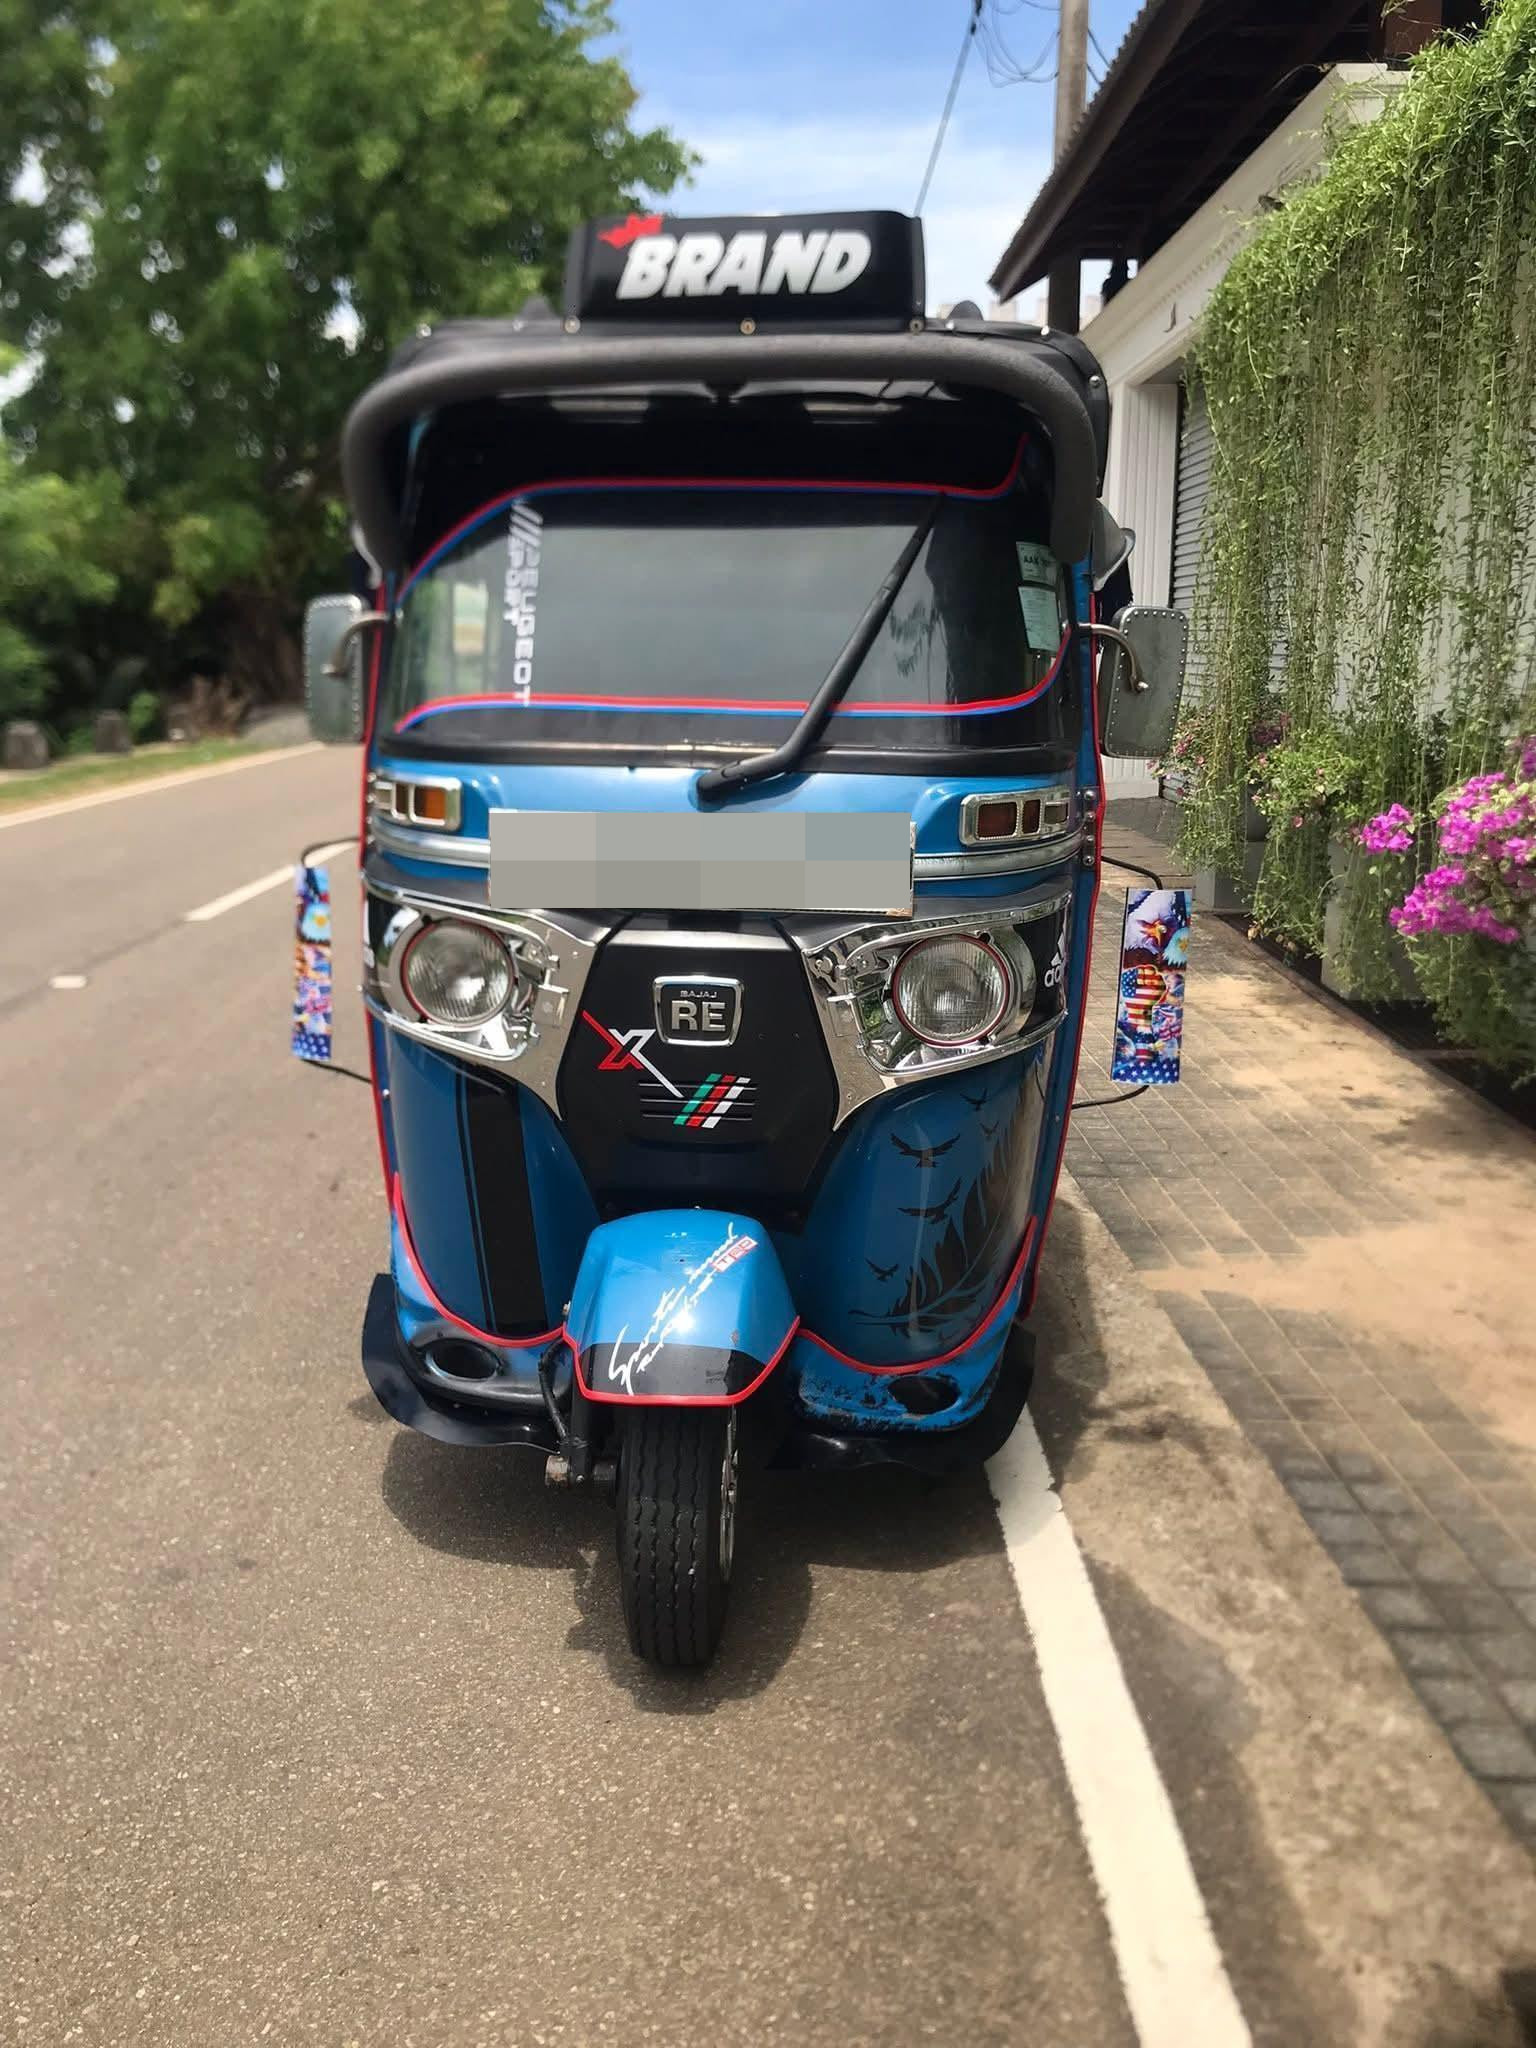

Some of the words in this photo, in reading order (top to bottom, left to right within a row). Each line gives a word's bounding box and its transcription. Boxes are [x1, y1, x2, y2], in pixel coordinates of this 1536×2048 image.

[615, 230, 871, 300] BRAND
[512, 543, 541, 707] PEUGEOT
[671, 1000, 726, 1032] RE
[680, 990, 718, 999] BAJAJ
